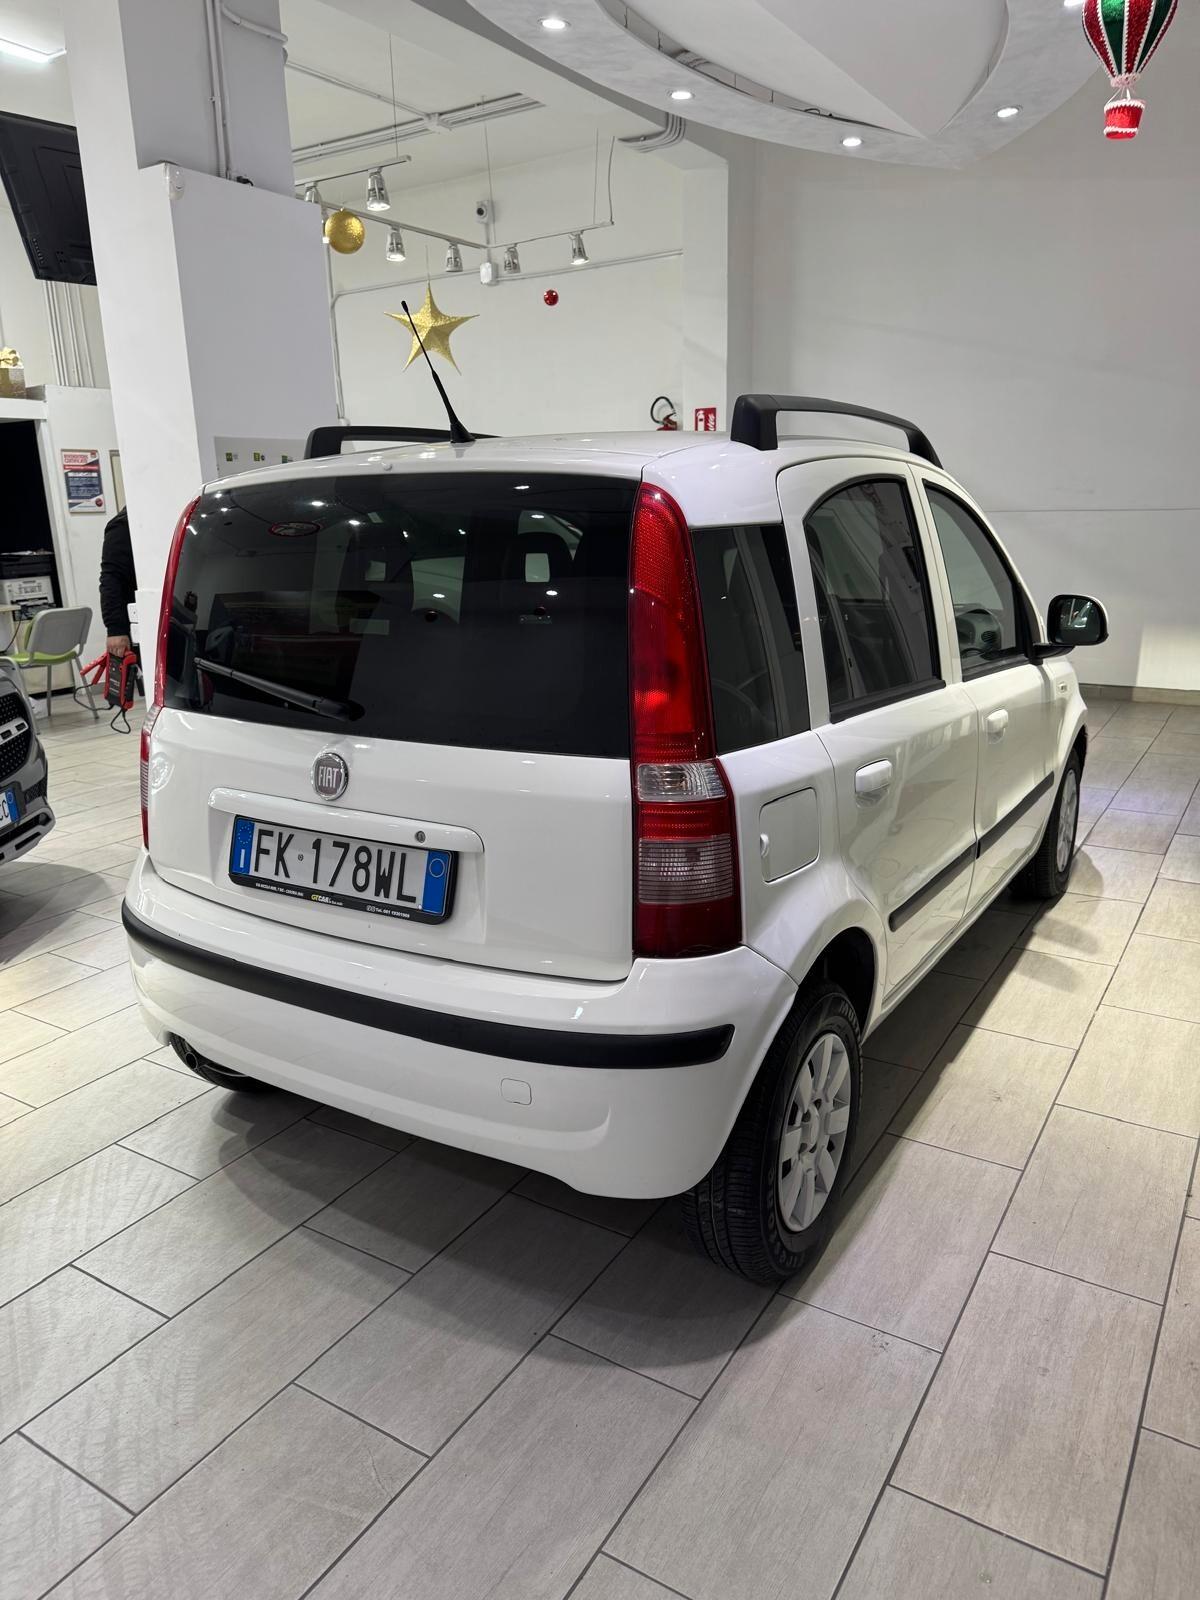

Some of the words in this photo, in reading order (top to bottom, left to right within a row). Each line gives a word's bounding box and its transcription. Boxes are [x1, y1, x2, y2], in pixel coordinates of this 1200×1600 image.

[318, 766, 340, 789] FIAT
[254, 828, 295, 879] FK
[311, 837, 417, 904] 178WL
